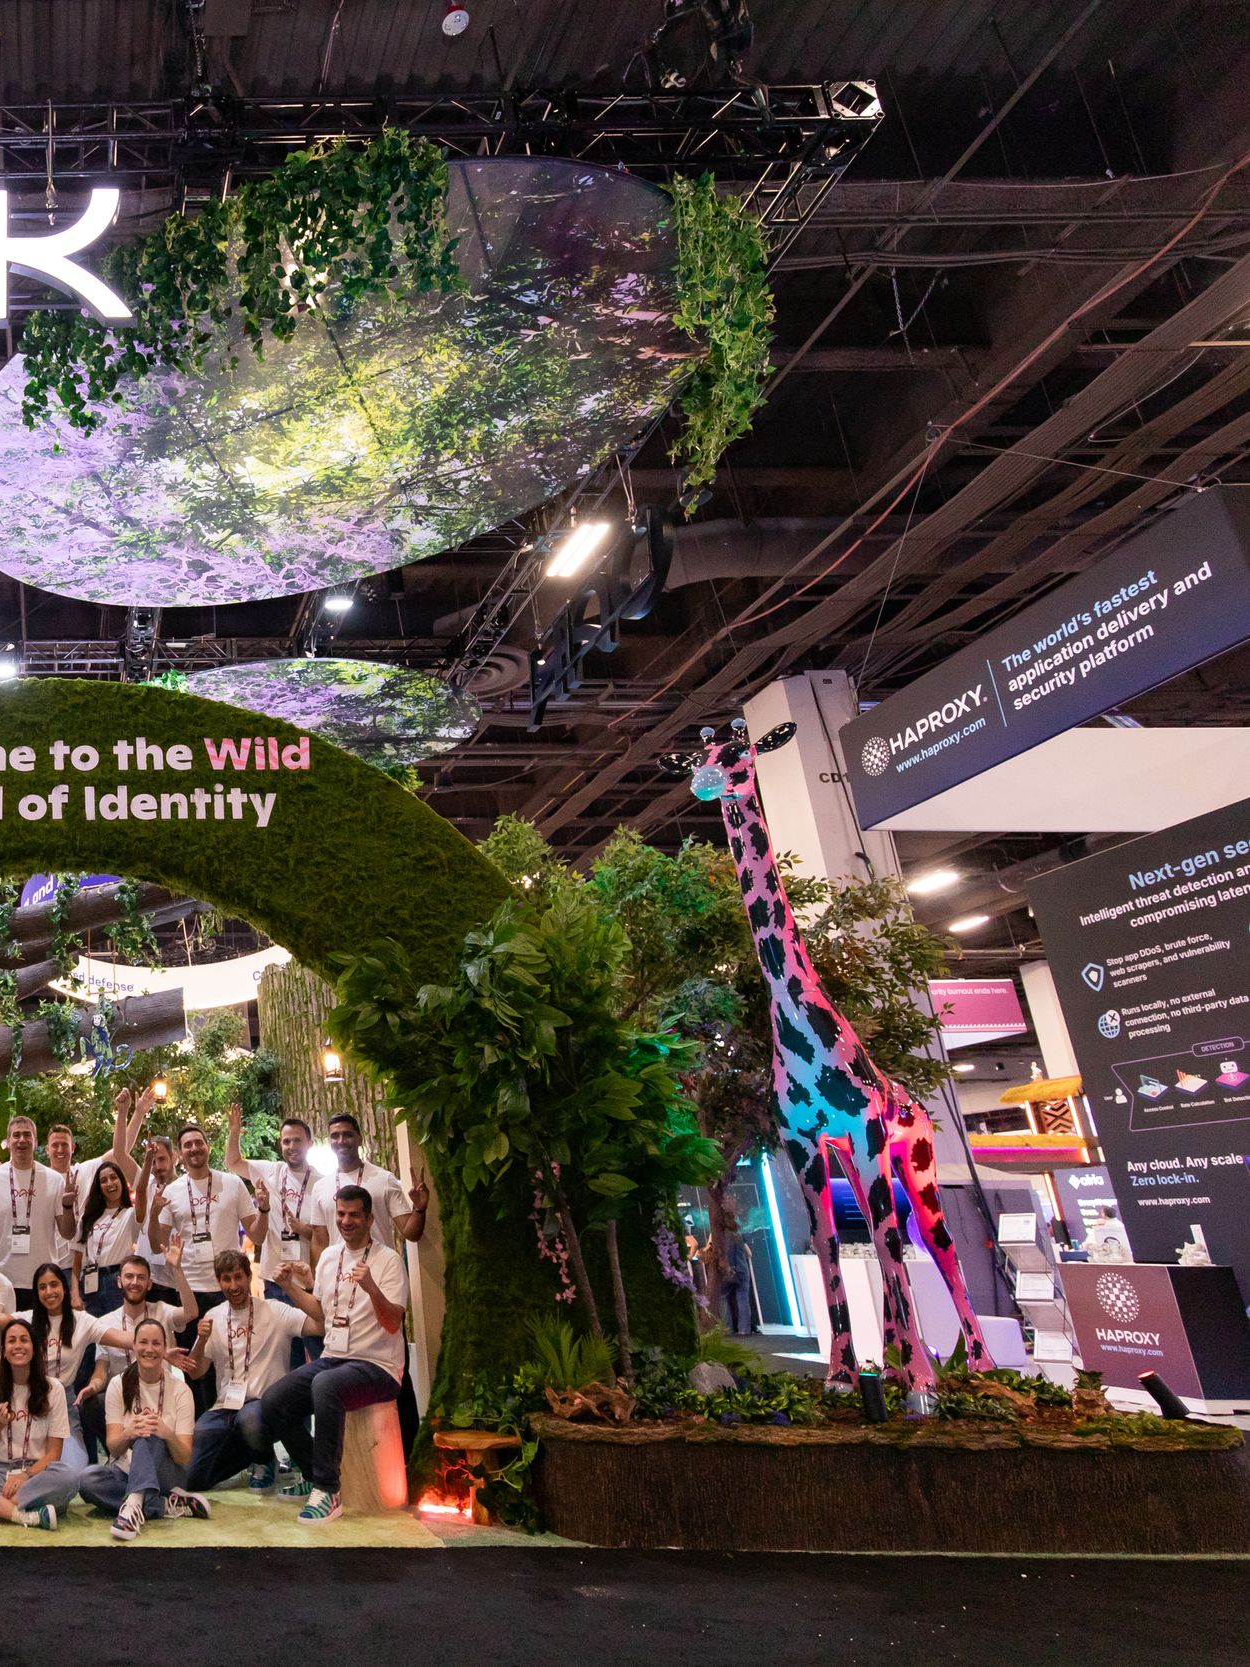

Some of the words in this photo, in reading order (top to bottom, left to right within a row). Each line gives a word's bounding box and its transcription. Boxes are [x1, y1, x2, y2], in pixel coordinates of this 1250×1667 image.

[1001, 649, 1031, 672] The
[1033, 612, 1092, 654] world's
[1094, 570, 1157, 618] fastest
[1008, 635, 1094, 692] application
[1096, 588, 1169, 641] delivery
[1173, 561, 1213, 596] and
[1013, 666, 1076, 711] security
[1079, 623, 1155, 678] platform
[50, 739, 104, 772] to
[113, 737, 192, 771] the
[204, 737, 311, 771] Wild
[895, 717, 986, 772] www.haproxy.com
[18, 784, 69, 822] of
[84, 783, 277, 828] Identity
[1128, 850, 1220, 890] Next-gen
[1223, 840, 1250, 859] se
[33, 875, 54, 904] and
[1079, 900, 1135, 927] Intelligent
[1135, 888, 1171, 909] threat
[1173, 870, 1234, 897] detection
[1130, 894, 1217, 928] compromising
[1106, 957, 1124, 967] Stop
[1125, 952, 1139, 962] app
[1164, 940, 1186, 951] brute
[1110, 968, 1125, 977] web
[1163, 953, 1178, 964] and
[1179, 940, 1230, 959] vulnerability
[88, 975, 135, 992] defense
[1113, 974, 1148, 988] scanners
[1121, 1006, 1140, 1017] Runs
[1170, 997, 1181, 1005] no
[1182, 988, 1216, 1002] external
[1170, 1009, 1181, 1018] no
[1182, 999, 1228, 1015] third-party
[1229, 994, 1249, 1006] data
[1128, 1023, 1171, 1040] processing
[1201, 1041, 1235, 1053] DETECTION
[1127, 1160, 1148, 1174] Any
[1149, 1157, 1184, 1170] cloud.
[1186, 1156, 1208, 1169] Any
[1210, 1153, 1244, 1166] scale
[1130, 1175, 1156, 1187] Zero
[1157, 1172, 1200, 1185] lock-in.
[1137, 1196, 1211, 1207] www.haproxy.com
[1095, 1328, 1160, 1346] HAPROXY
[1100, 1344, 1164, 1357] www.haproxy.com
